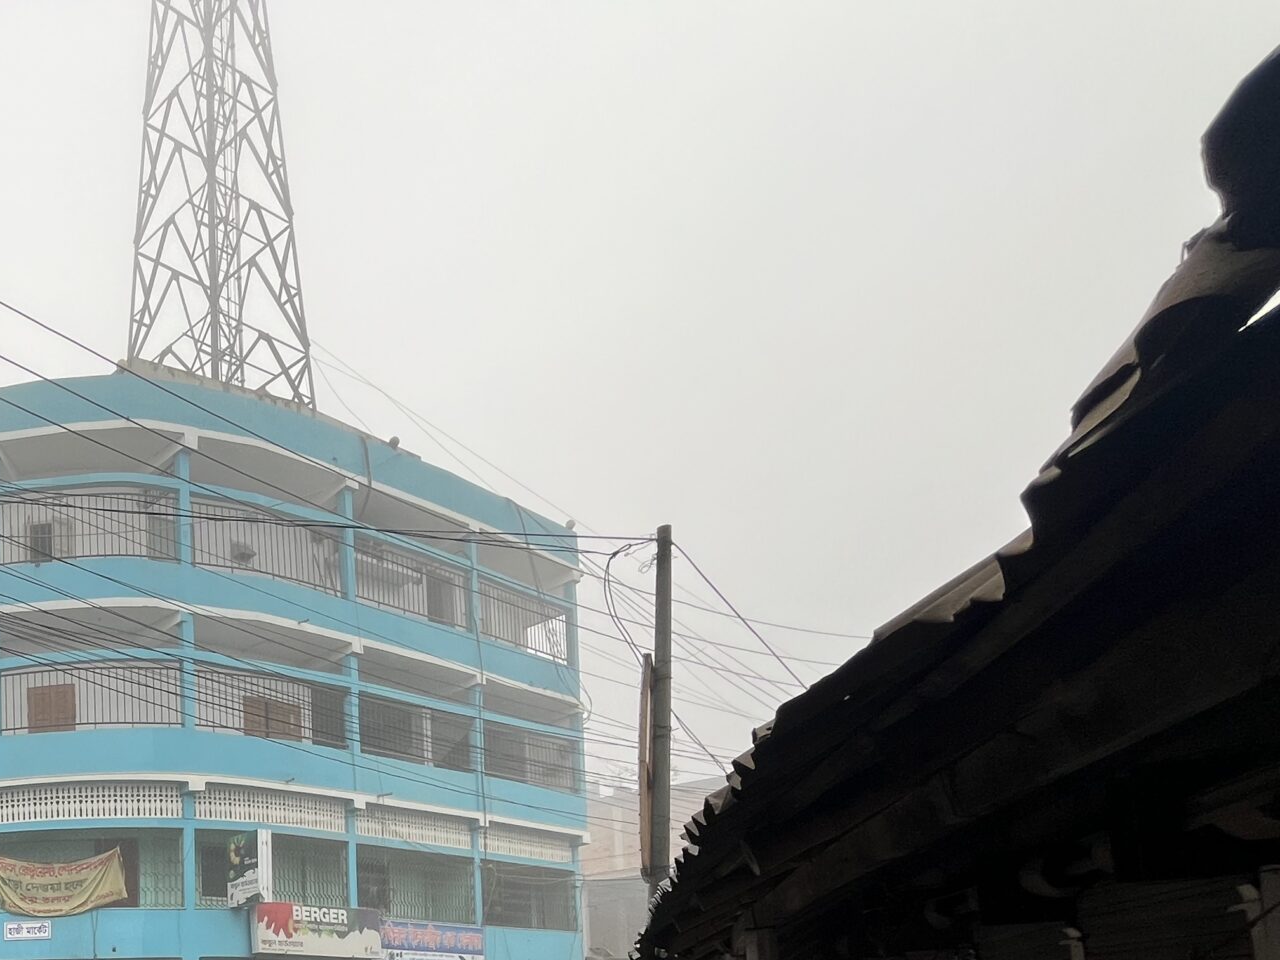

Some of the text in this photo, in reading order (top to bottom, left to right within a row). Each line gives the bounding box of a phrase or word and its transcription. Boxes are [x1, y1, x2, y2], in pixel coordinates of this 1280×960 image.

[292, 905, 348, 924] BERGER
[8, 924, 48, 936] হাজী মার্কেট
